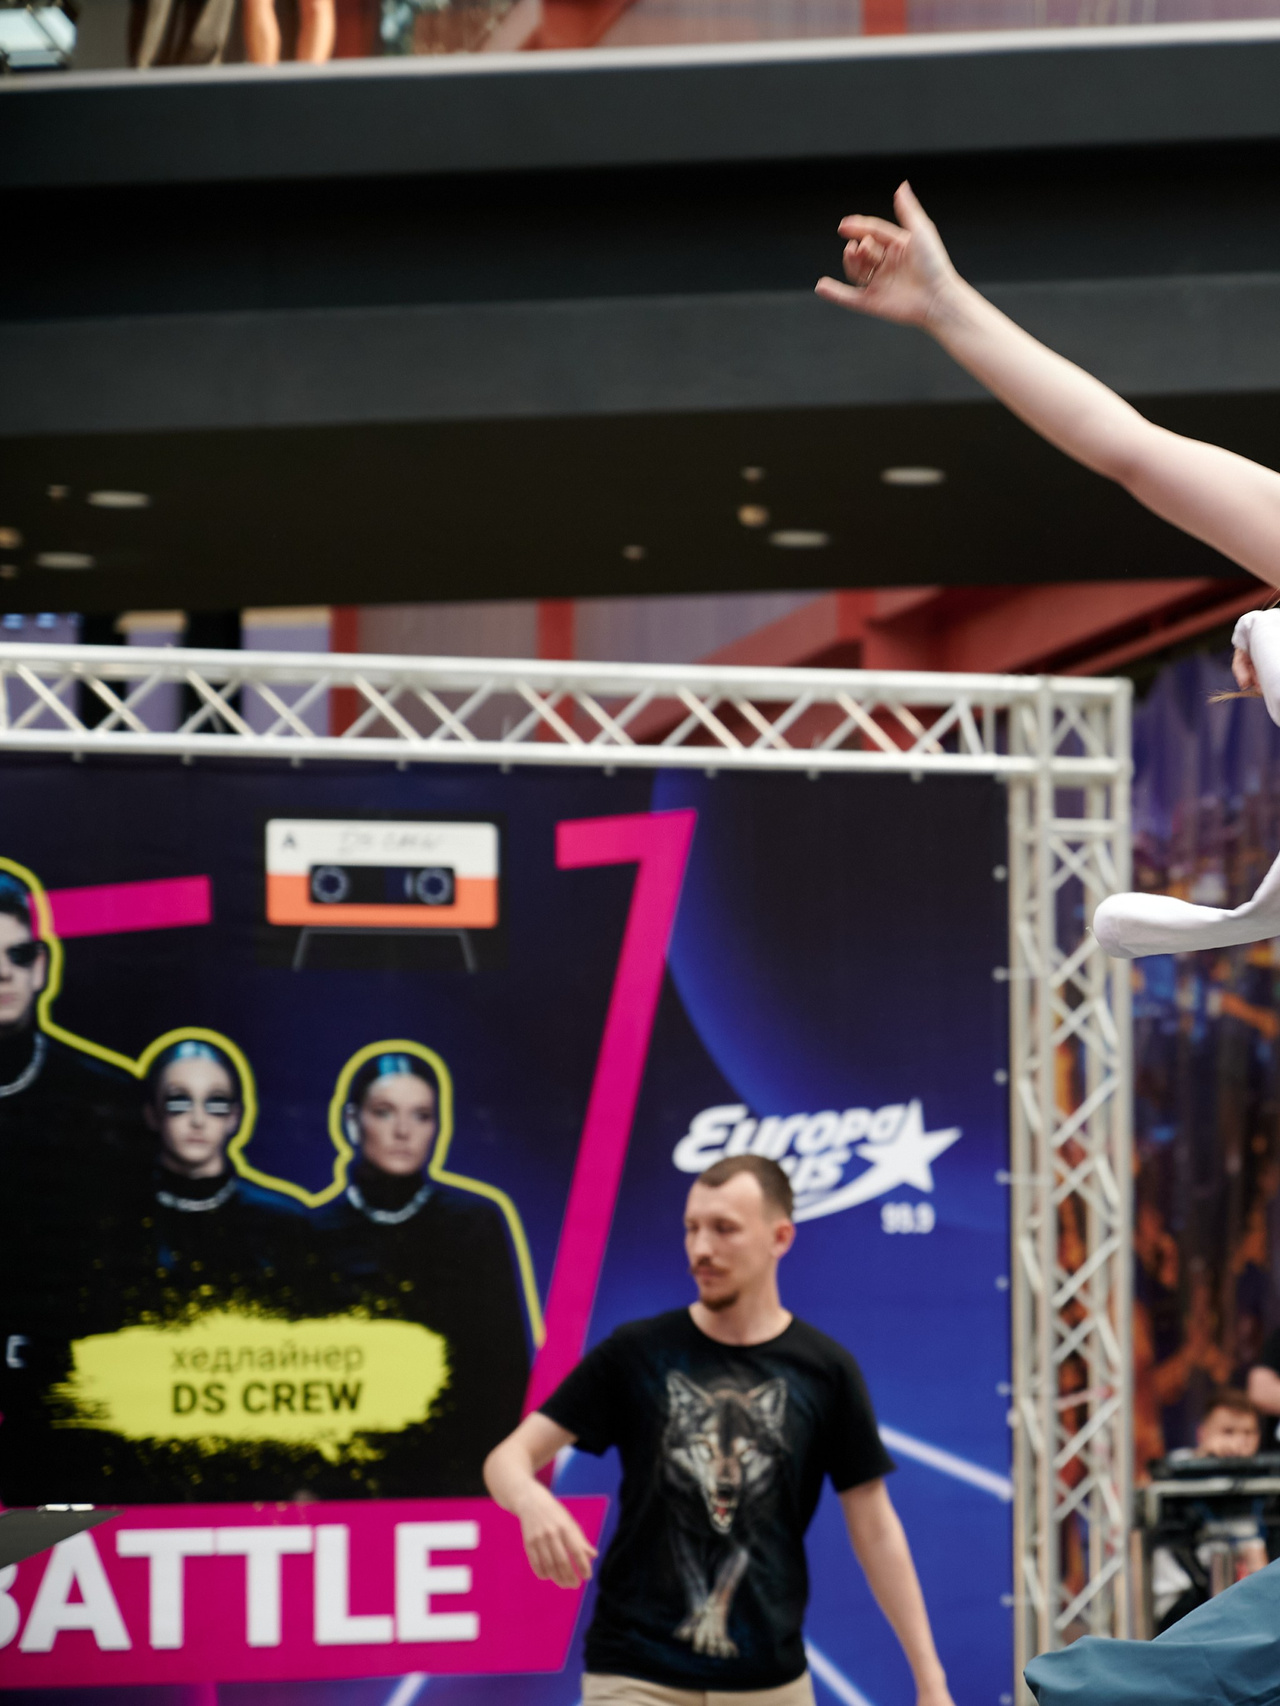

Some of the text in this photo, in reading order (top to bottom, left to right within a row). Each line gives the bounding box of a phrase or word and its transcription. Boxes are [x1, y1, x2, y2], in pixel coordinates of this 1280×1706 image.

[673, 1103, 907, 1174] Europa
[170, 1340, 364, 1377] хедлайнер
[172, 1381, 362, 1414] DS CREW
[0, 1520, 481, 1653] ATTLE
